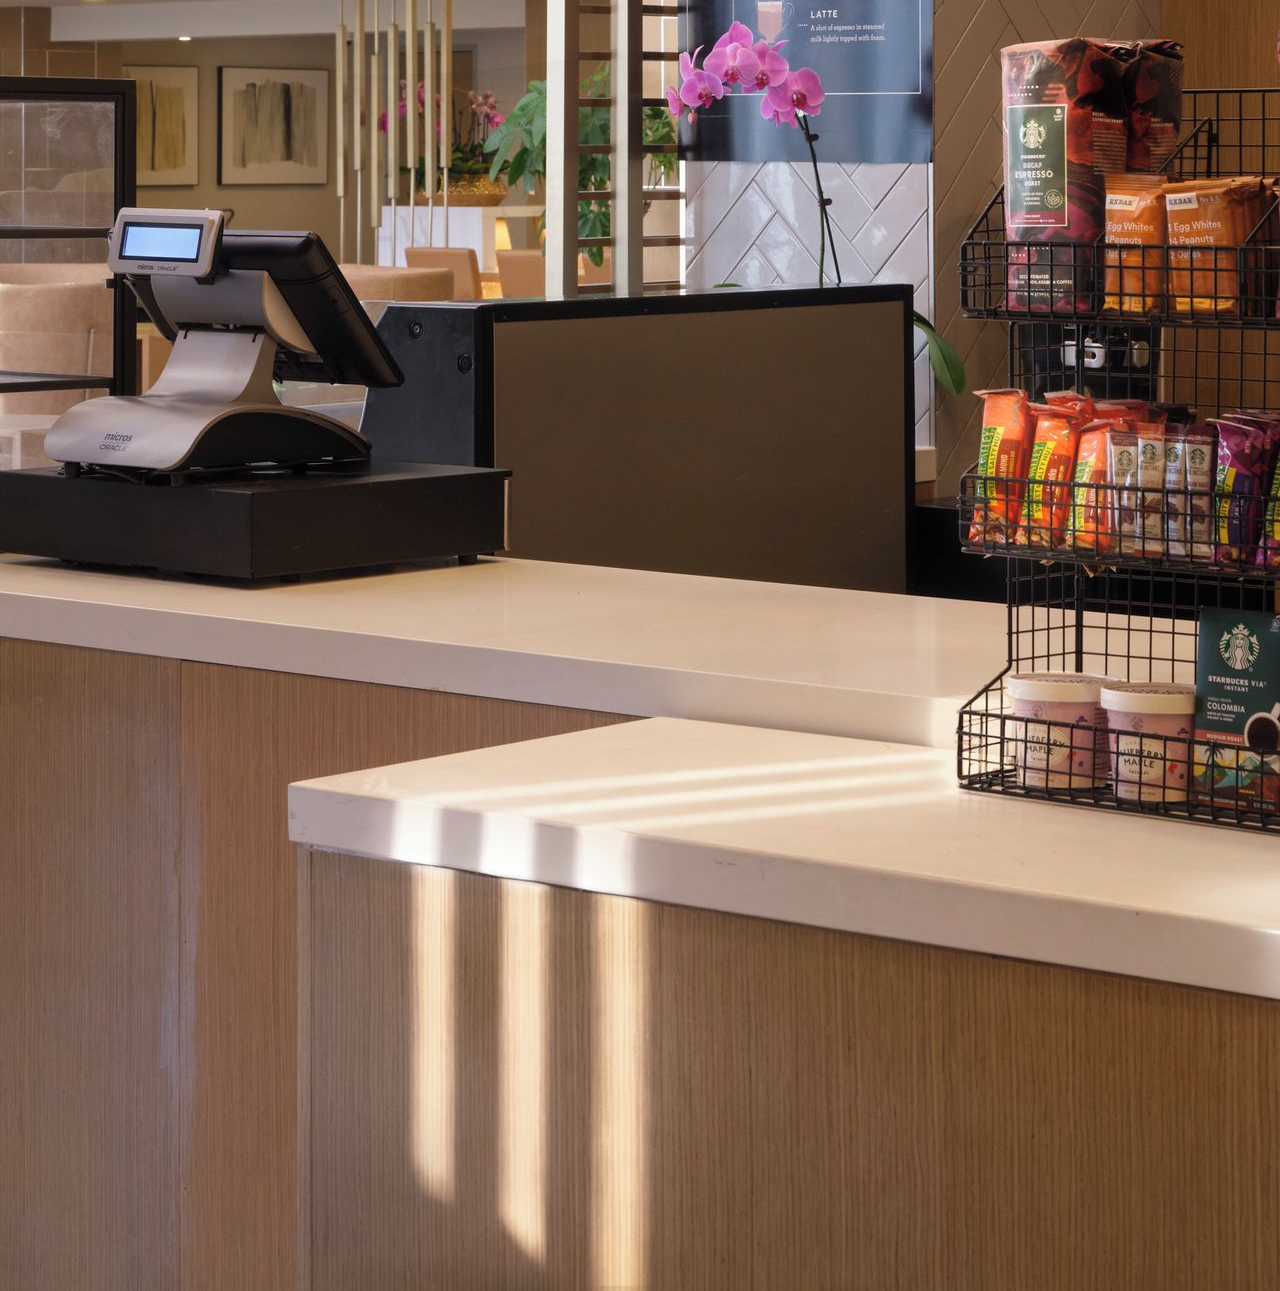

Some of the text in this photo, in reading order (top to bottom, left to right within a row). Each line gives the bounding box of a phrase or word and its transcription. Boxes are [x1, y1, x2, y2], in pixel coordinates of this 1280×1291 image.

[810, 10, 838, 18] LATTE
[1015, 170, 1053, 179] ESPRESSO
[1108, 198, 1134, 206] RXBAR
[1168, 197, 1192, 206] RXBAR
[1107, 222, 1155, 232] Egg Whites
[1173, 221, 1222, 233] Egg Whites
[1109, 235, 1142, 244] Peanuts
[1180, 235, 1214, 245] Peanuts
[104, 431, 133, 442] micros
[99, 444, 128, 452] ORACLE
[1042, 445, 1052, 461] NUT
[989, 447, 997, 470] SALTY
[1208, 675, 1249, 686] STARBUCKS
[1207, 702, 1245, 713] COLOMBIA
